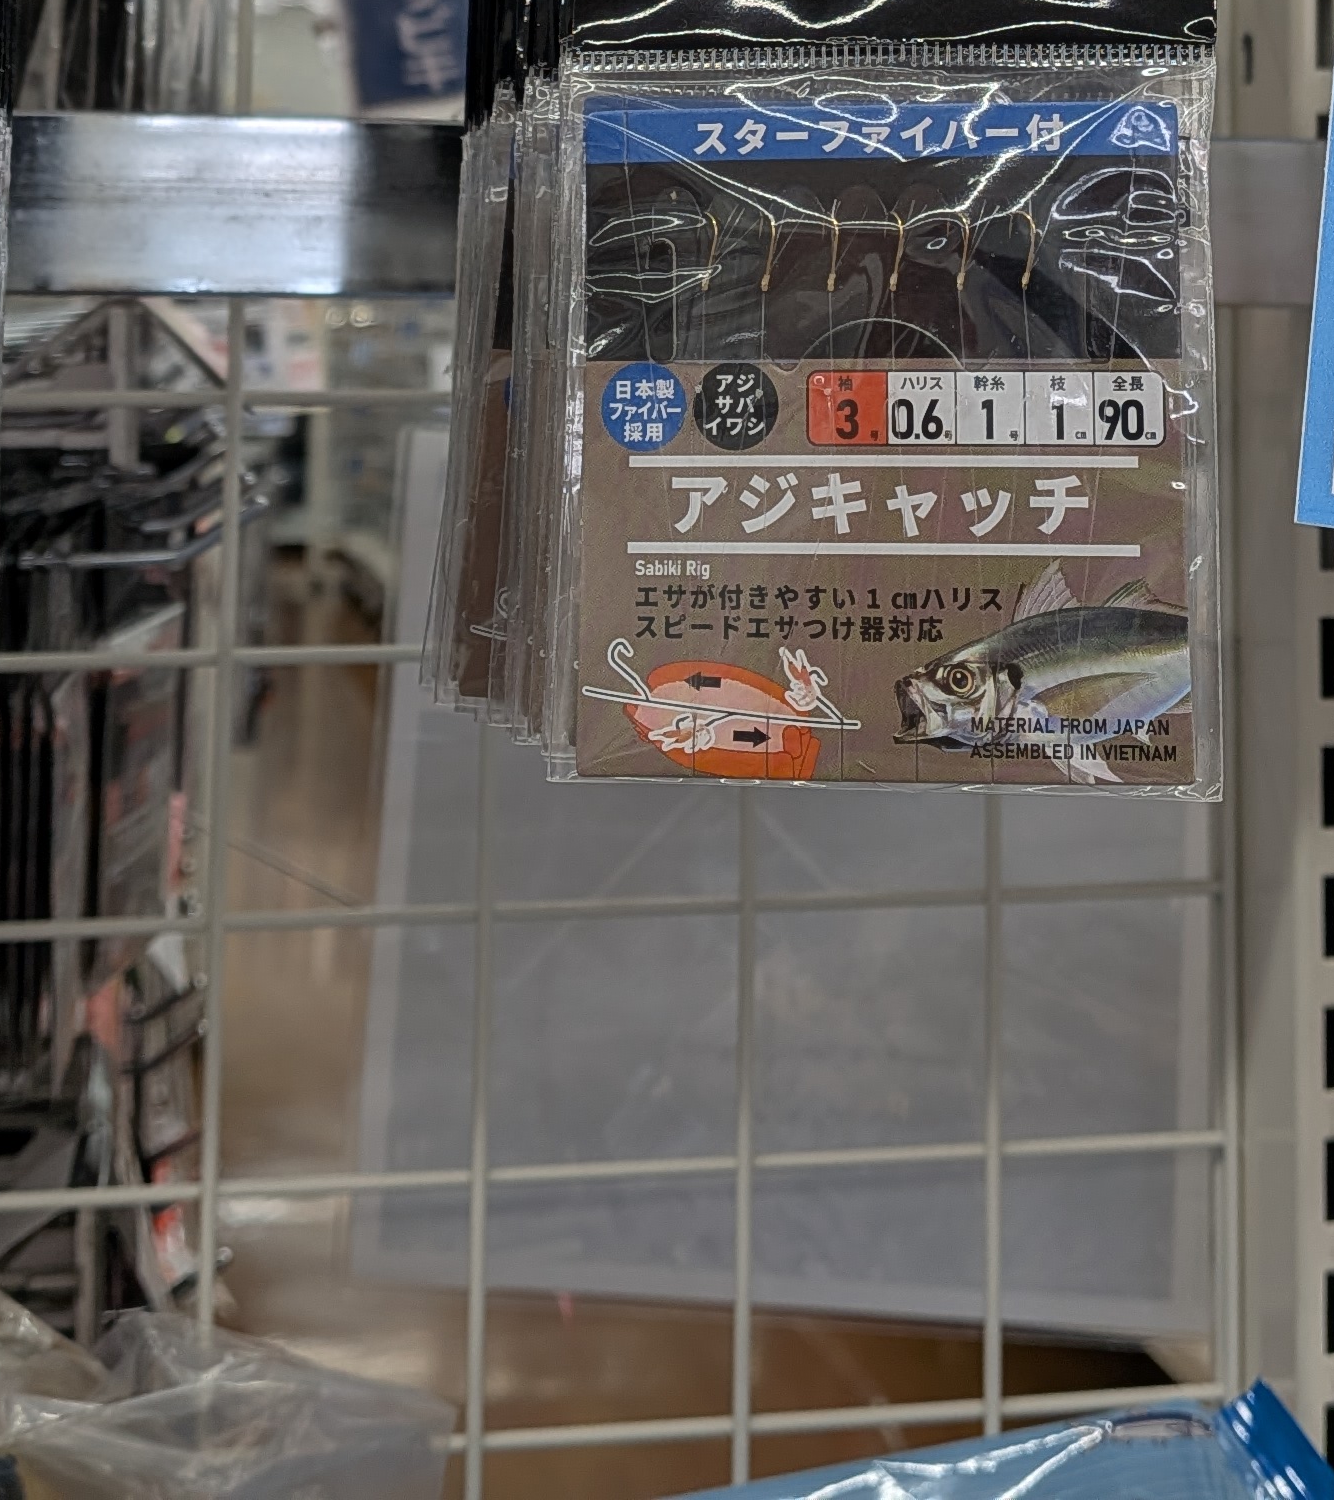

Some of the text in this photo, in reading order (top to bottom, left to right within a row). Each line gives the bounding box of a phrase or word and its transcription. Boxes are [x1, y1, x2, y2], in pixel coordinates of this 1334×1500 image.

[693, 115, 1062, 156] スターファイバー付
[613, 378, 676, 401] 日本製
[715, 372, 756, 393] アジ
[899, 374, 944, 393] ハリス
[972, 374, 1006, 393] 幹糸
[1049, 374, 1067, 393] 枝
[1111, 373, 1146, 393] 全長
[608, 400, 682, 422] ファイバー
[714, 392, 755, 415] サバ
[703, 414, 766, 437] イワシ
[834, 399, 1145, 442] 3 0.6 1 1 90
[623, 421, 663, 444] 採用
[670, 472, 1090, 539] アジキャッチ
[635, 558, 711, 581] Sabiki Rig
[634, 615, 944, 643] スピードエサつけ器対応
[970, 716, 1170, 737] MATERIAL FROM JAPAN
[969, 742, 1178, 763] ASSEMBLED IN VIETNAM
